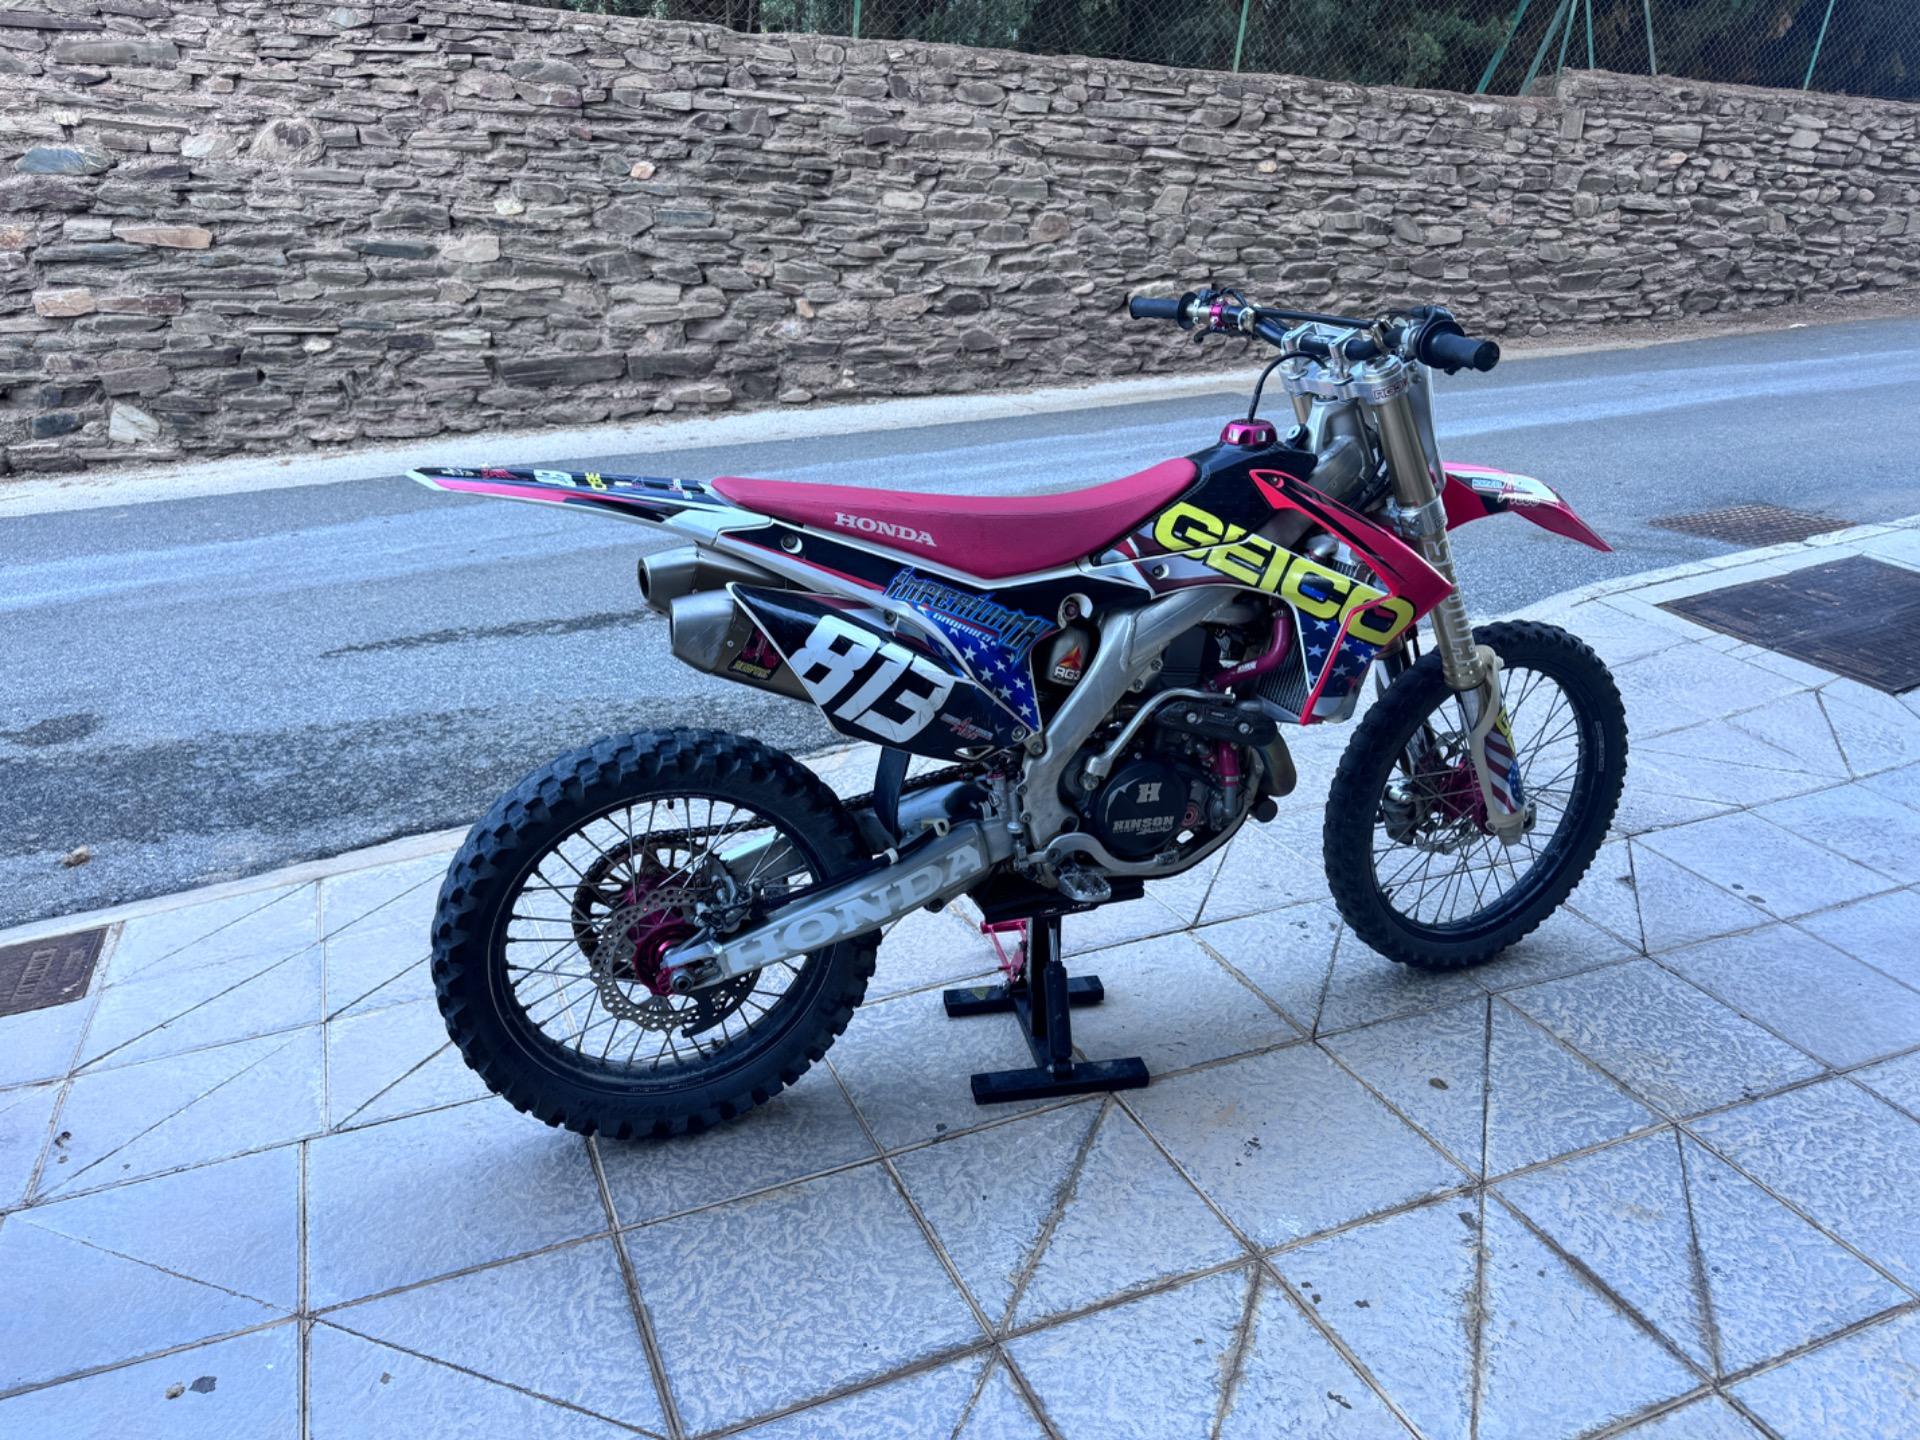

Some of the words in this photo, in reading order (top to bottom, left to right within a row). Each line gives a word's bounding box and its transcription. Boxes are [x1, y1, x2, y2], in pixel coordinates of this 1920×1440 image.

[834, 511, 937, 548] HONDA
[1153, 502, 1415, 646] GEICO
[790, 614, 956, 743] 813
[1054, 666, 1081, 680] RG3
[1136, 782, 1162, 803] H
[1113, 816, 1174, 832] HINSON
[726, 844, 983, 974] HONDA
